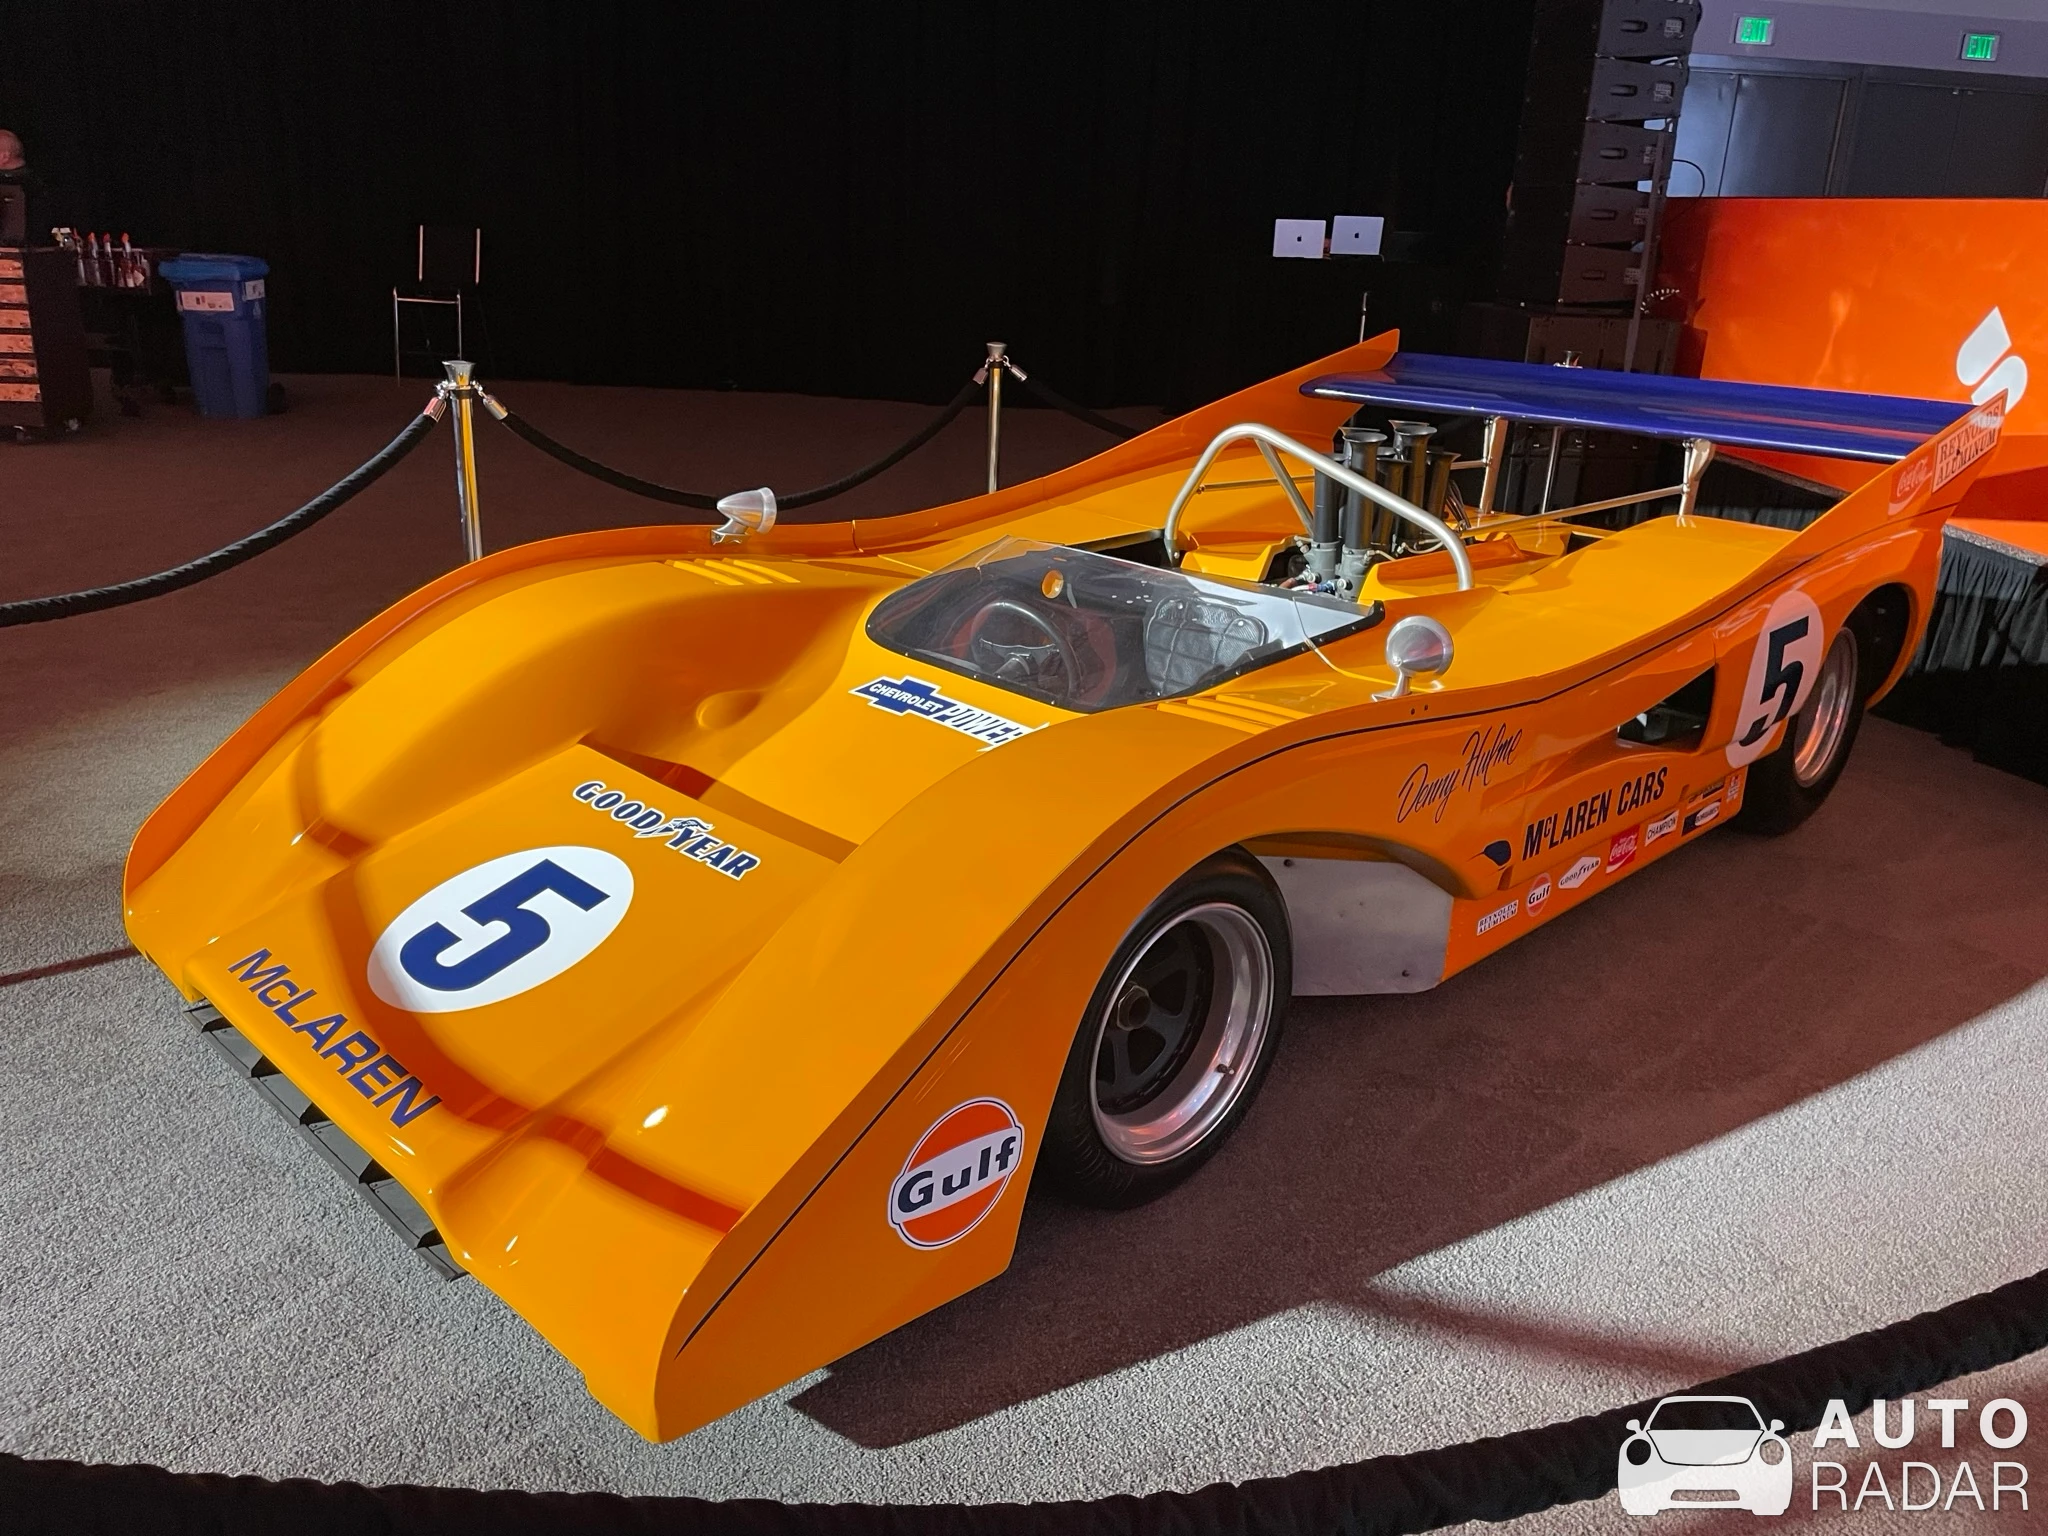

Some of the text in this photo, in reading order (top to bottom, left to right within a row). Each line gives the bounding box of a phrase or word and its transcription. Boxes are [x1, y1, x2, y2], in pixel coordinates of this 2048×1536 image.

[1741, 18, 1771, 43] EXIT
[1967, 35, 1996, 59] EXIT
[1936, 427, 1997, 488] ALUMINUM
[869, 683, 944, 713] CHEVROLET
[1738, 616, 1810, 748] 5
[1397, 722, 1523, 824] Denny Hulme
[1616, 766, 1669, 817] CARS
[573, 781, 762, 881] GOODYEAR
[1646, 816, 1678, 841] CHAMPION
[1479, 902, 1518, 927] REYNOLDS
[1528, 885, 1551, 905] Gulf
[400, 858, 612, 992] 5
[228, 948, 443, 1129] McLAREN
[898, 1136, 1016, 1213] Gulf
